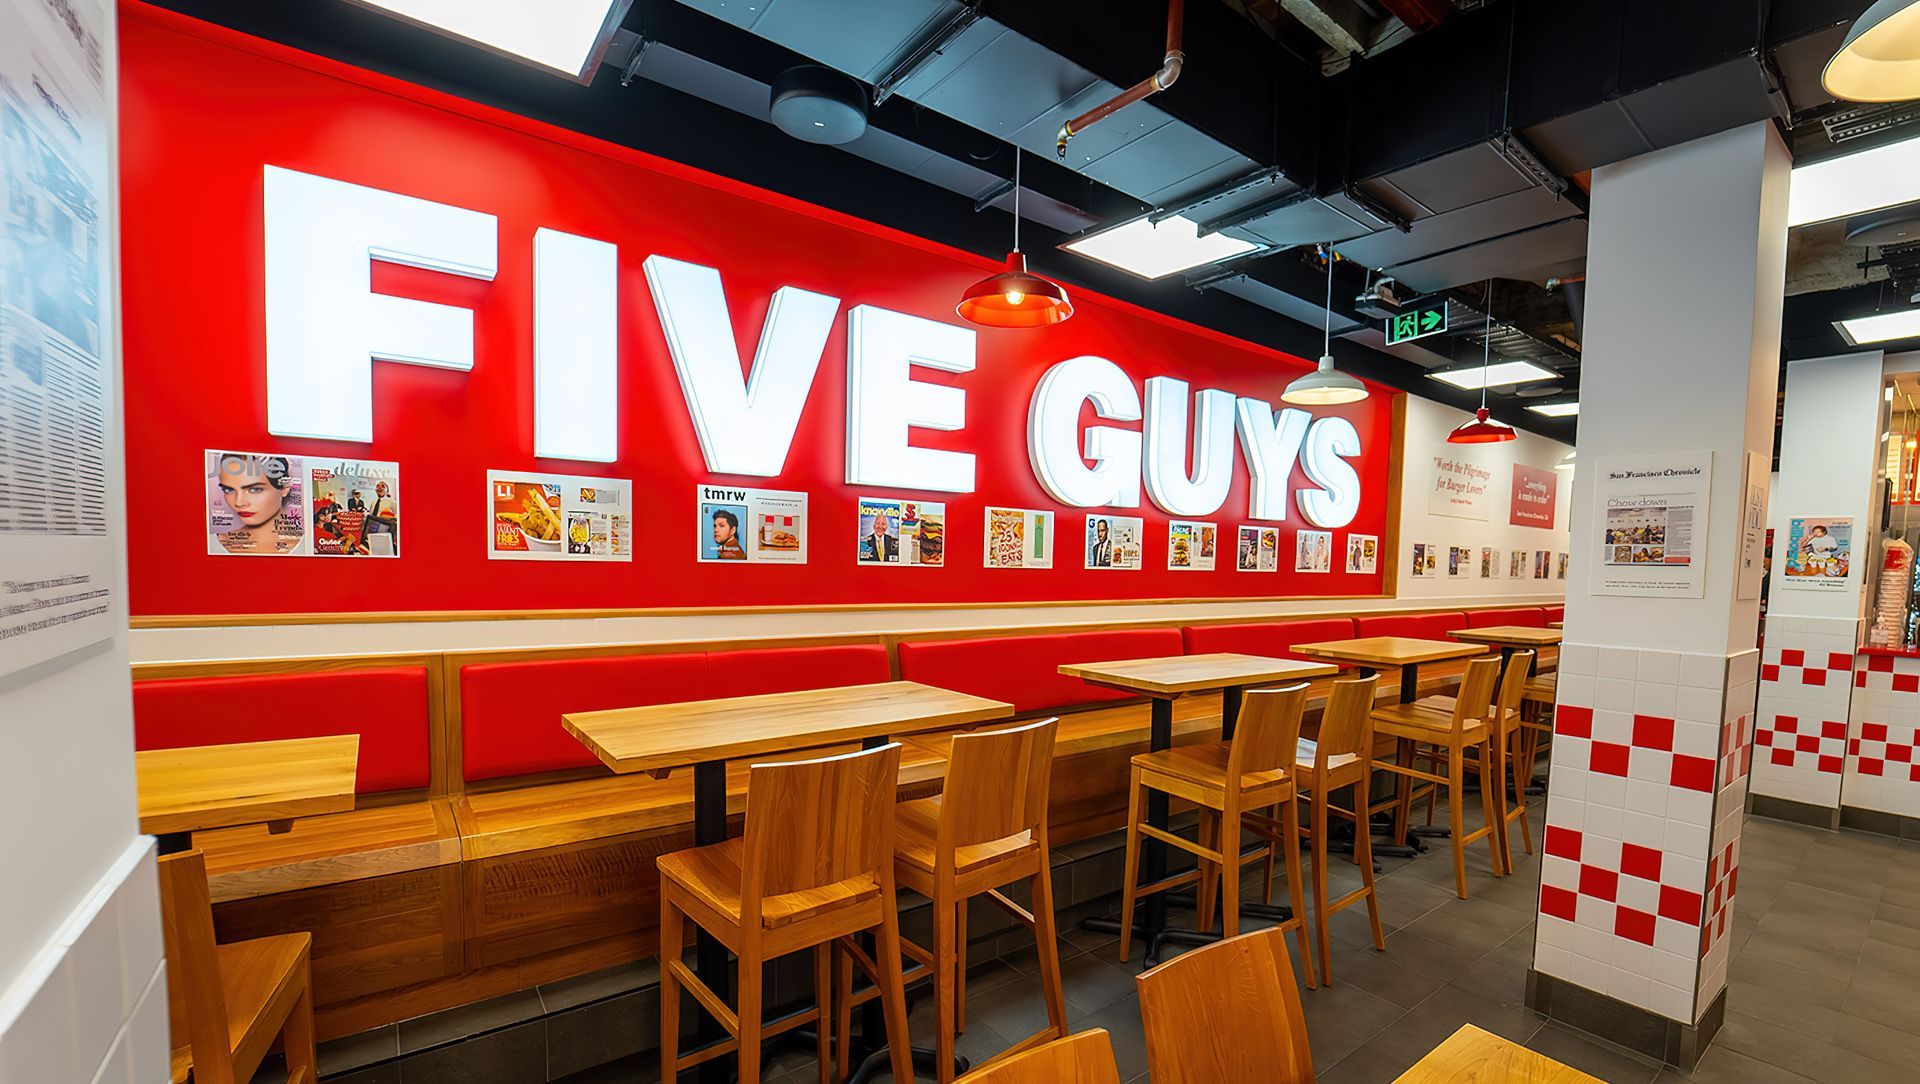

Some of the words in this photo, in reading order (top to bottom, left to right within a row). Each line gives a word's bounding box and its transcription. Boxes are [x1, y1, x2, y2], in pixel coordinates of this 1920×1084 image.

[264, 164, 977, 493] FIVE
[1027, 355, 1362, 529] GUYS
[334, 462, 391, 478] deluxe
[1625, 470, 1662, 479] Francisco
[1663, 467, 1701, 477] Chronicle
[704, 487, 746, 501] tmrw
[1607, 498, 1637, 507] Chow
[1638, 497, 1667, 506] down
[1000, 531, 1013, 543] 25
